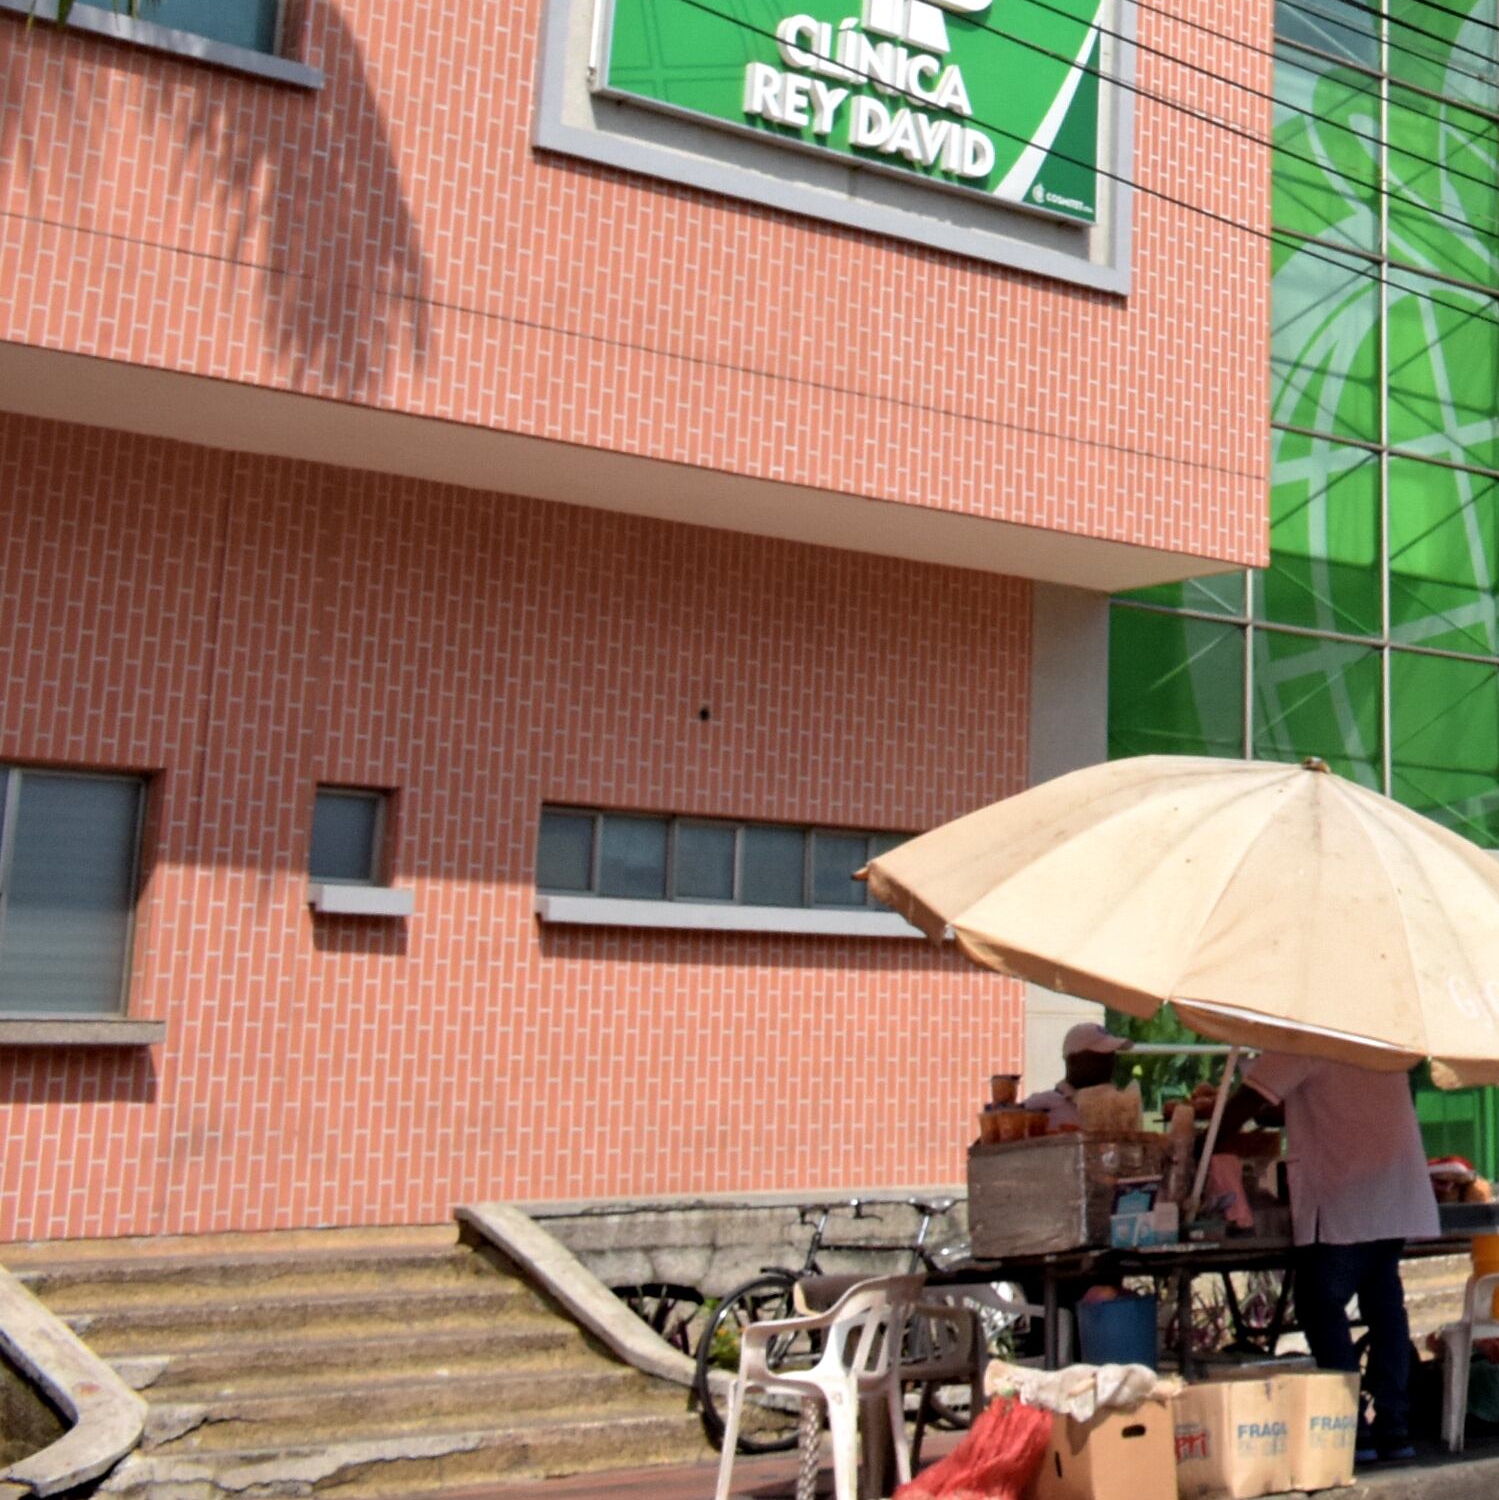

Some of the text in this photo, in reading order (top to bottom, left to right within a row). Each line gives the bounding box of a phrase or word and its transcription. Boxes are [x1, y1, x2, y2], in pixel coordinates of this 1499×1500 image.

[744, 62, 995, 178] REY DAVID
[777, 14, 973, 117] CLÍNICA
